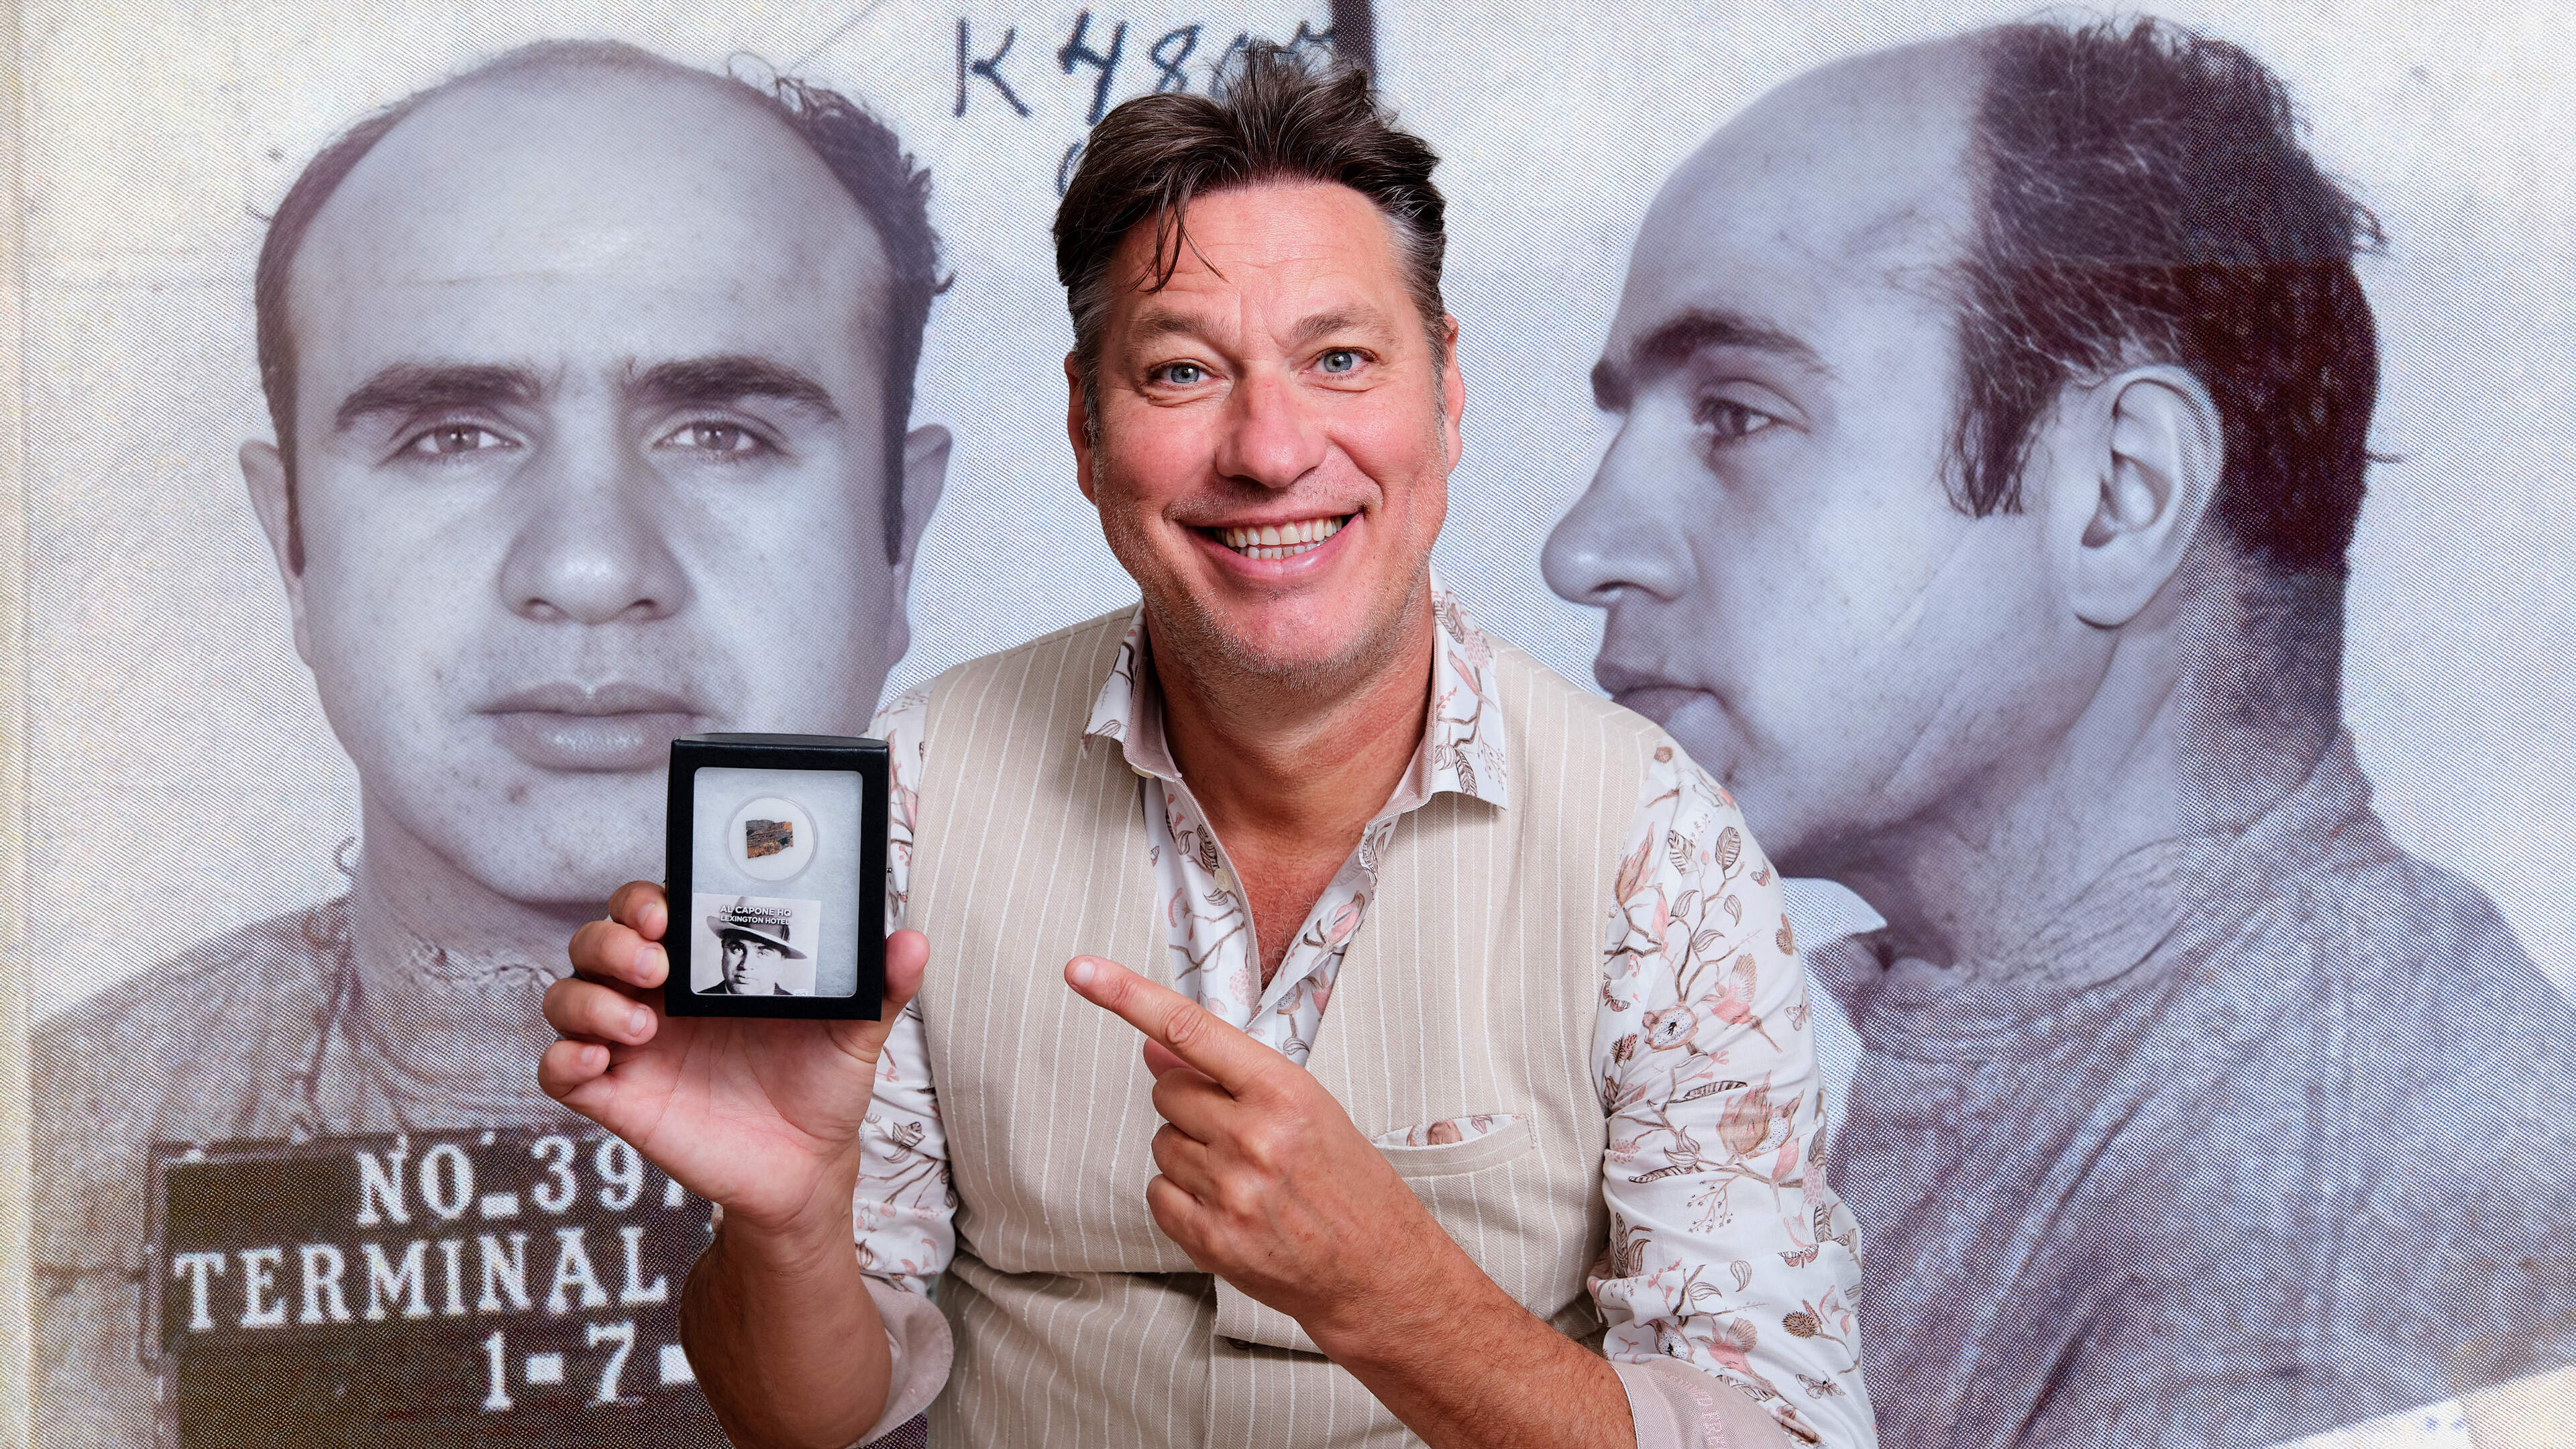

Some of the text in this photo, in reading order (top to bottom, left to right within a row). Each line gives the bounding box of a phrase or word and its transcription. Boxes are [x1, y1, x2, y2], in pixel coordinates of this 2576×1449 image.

[720, 905, 792, 916] AL CAPONE HQ
[720, 914, 790, 925] LEXINGTON HOTEL
[173, 1225, 668, 1332] TERMINAL
